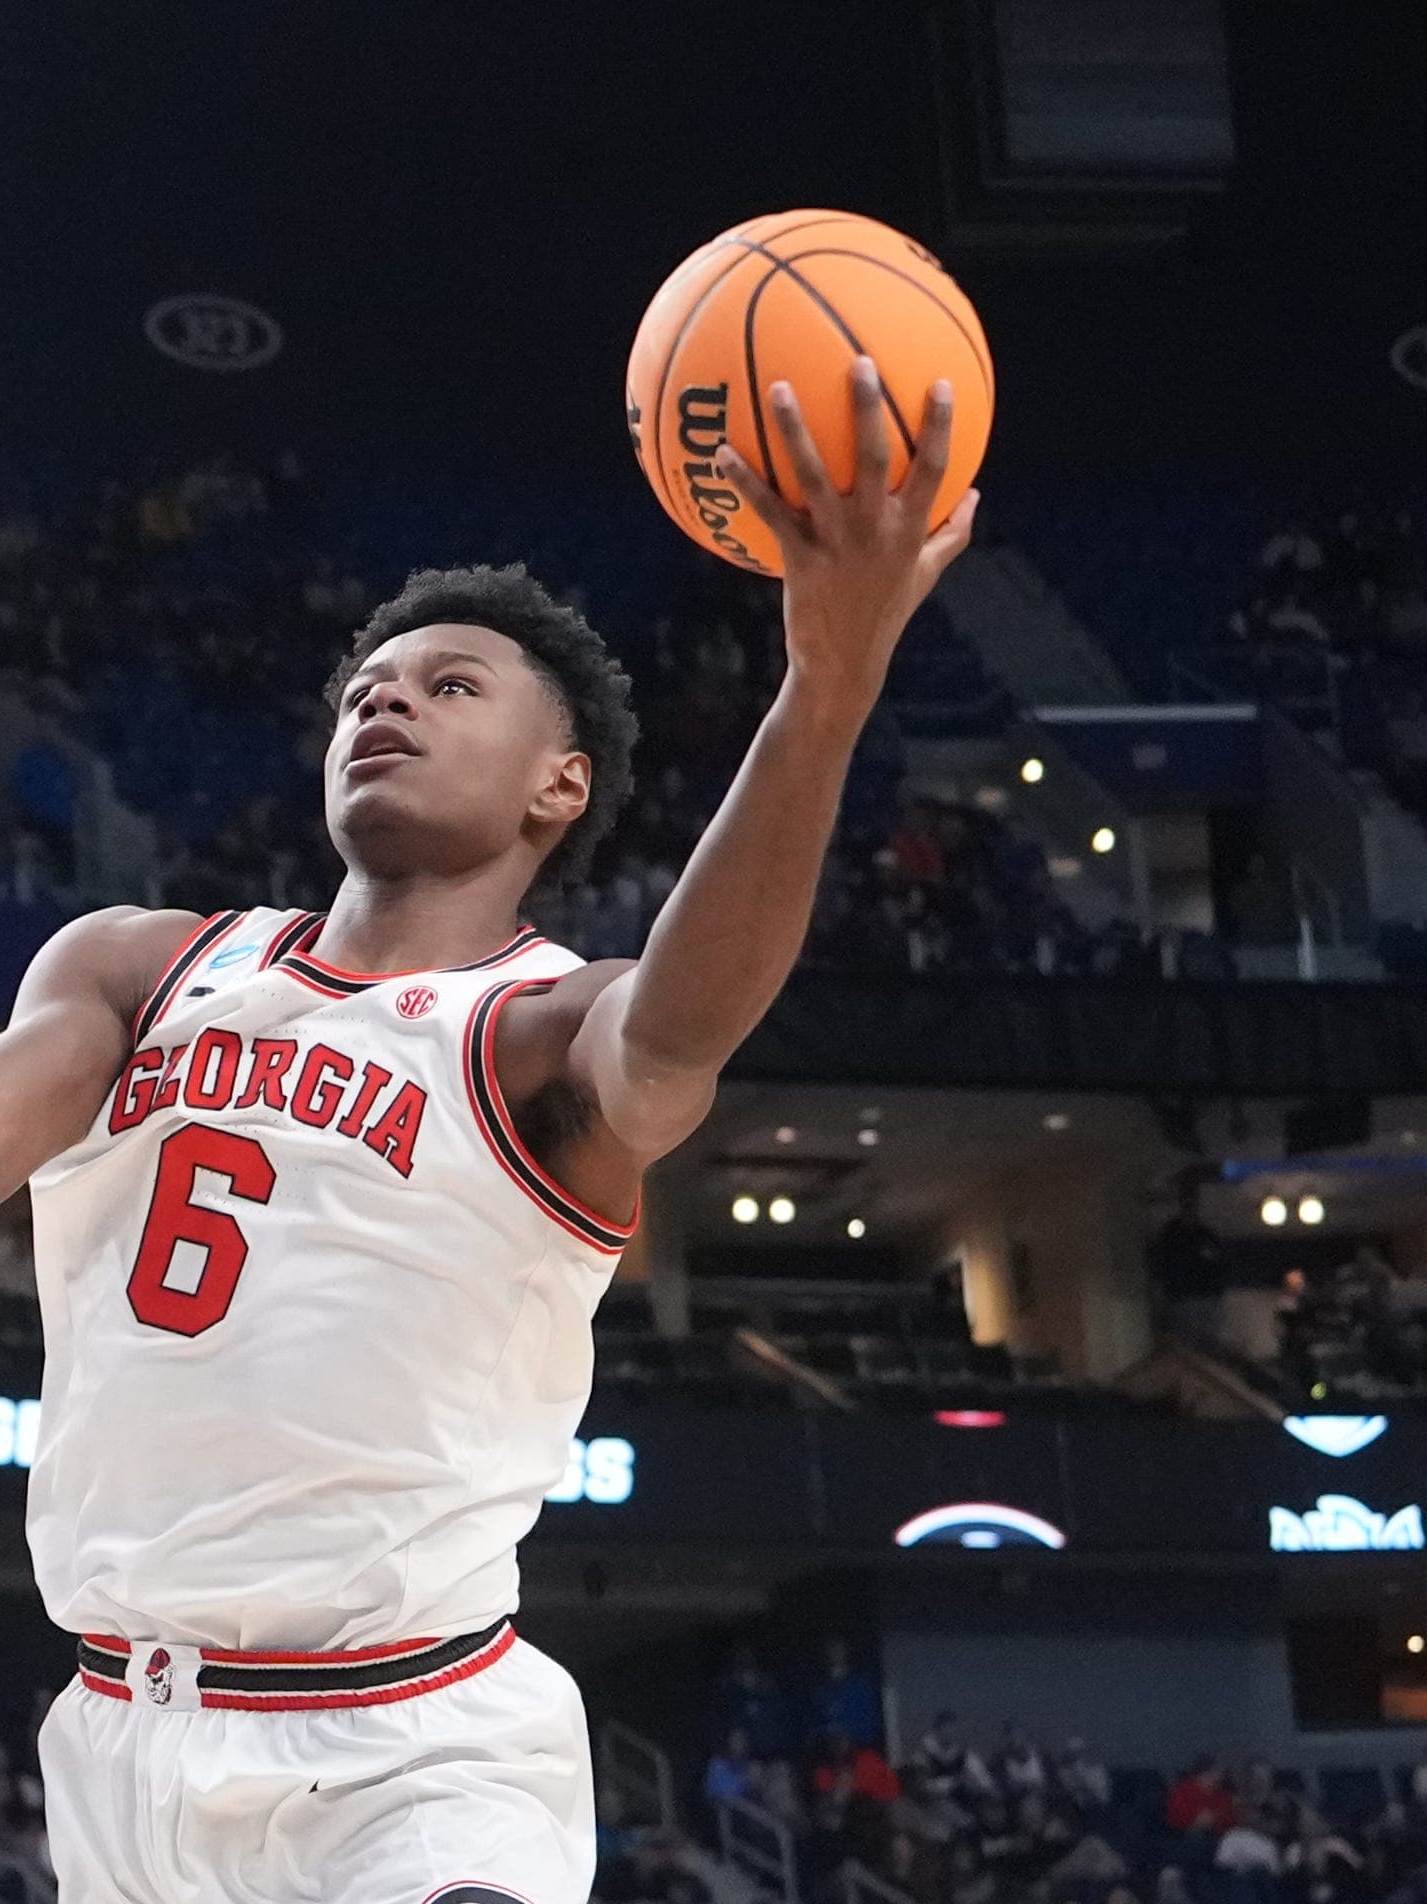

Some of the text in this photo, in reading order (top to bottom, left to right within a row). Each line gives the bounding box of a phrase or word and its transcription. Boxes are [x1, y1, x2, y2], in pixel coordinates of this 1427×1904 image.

[400, 988, 434, 1015] SEC
[109, 1027, 427, 1179] GEORGIA
[126, 1122, 276, 1336] 6
